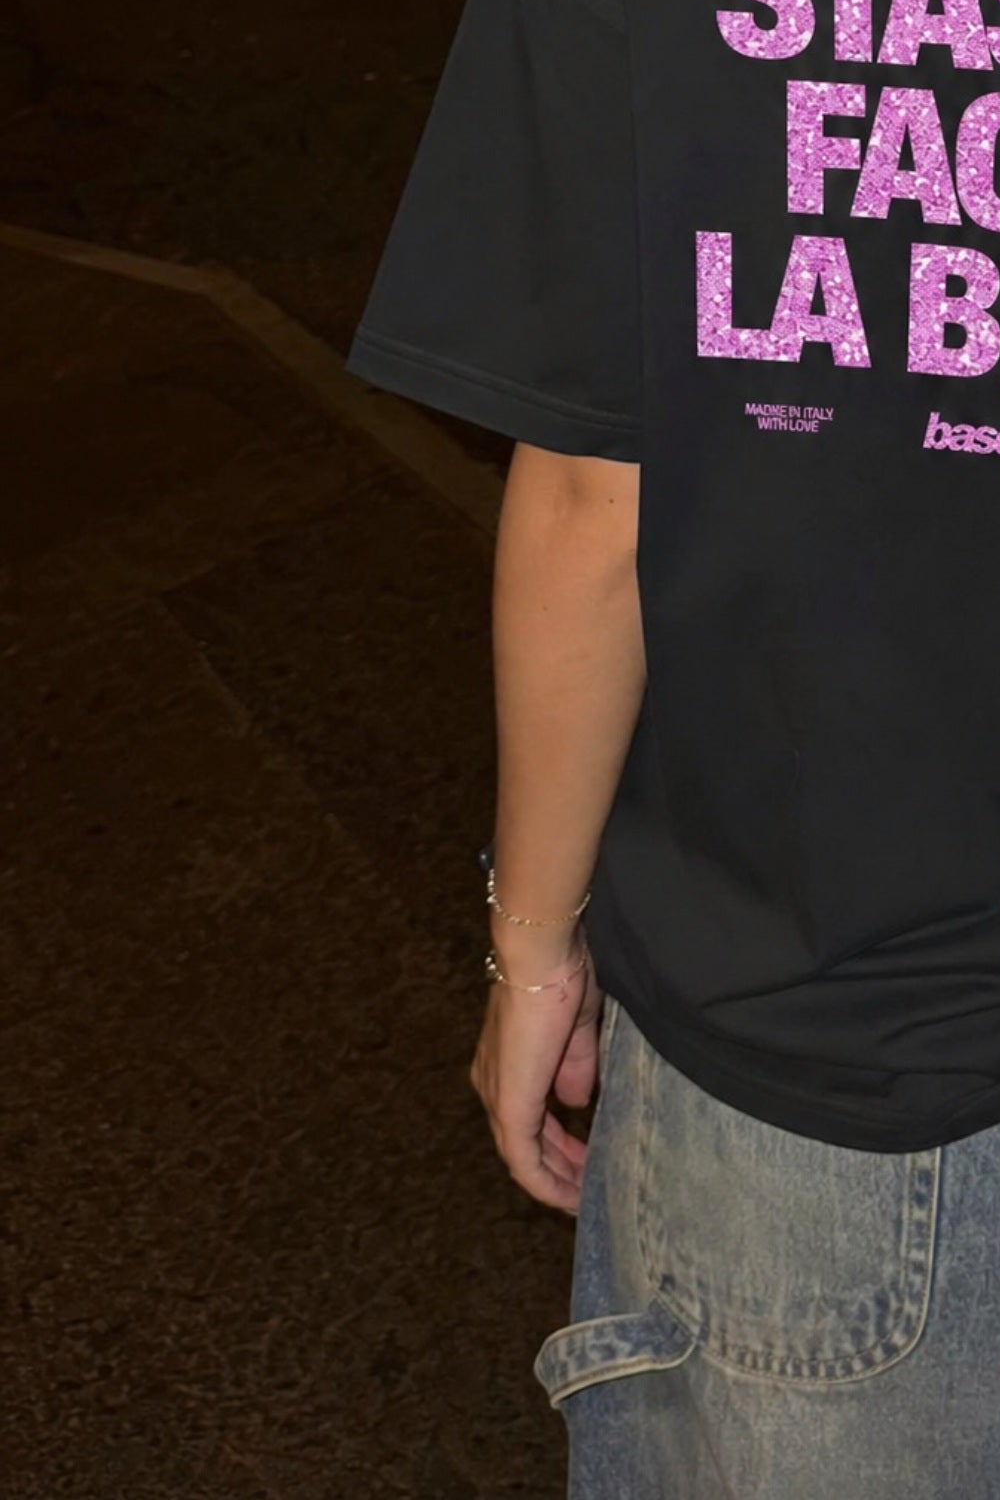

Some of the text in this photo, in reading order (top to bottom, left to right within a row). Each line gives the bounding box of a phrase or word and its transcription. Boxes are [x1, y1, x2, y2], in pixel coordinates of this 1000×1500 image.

[695, 231, 873, 370] LA
[788, 405, 801, 418] IN
[803, 407, 834, 421] ITALY
[757, 416, 820, 433] WITH LOVE
